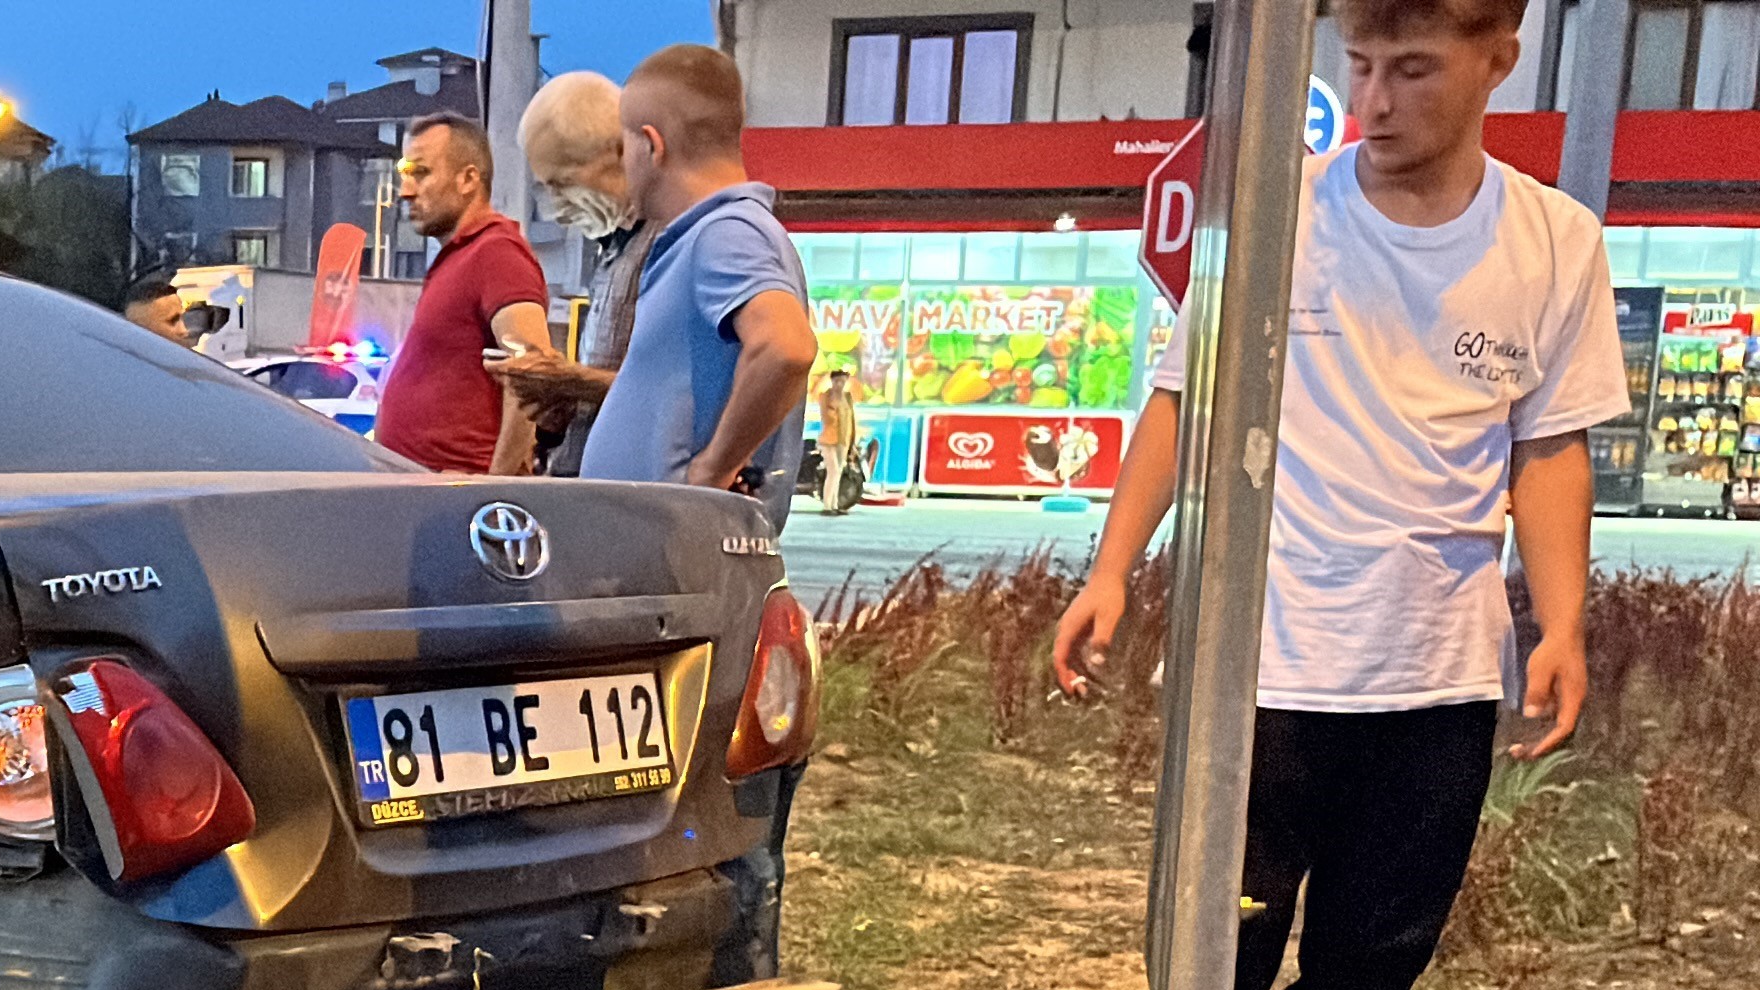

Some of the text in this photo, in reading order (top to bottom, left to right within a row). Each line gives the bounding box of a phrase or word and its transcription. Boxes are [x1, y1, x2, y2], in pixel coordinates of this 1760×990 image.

[916, 302, 1061, 333] MARKET
[1454, 331, 1486, 359] GO
[946, 458, 992, 470] ALGIDA
[40, 565, 163, 602] TOYOTA
[358, 684, 660, 787] TR 81 BE 112
